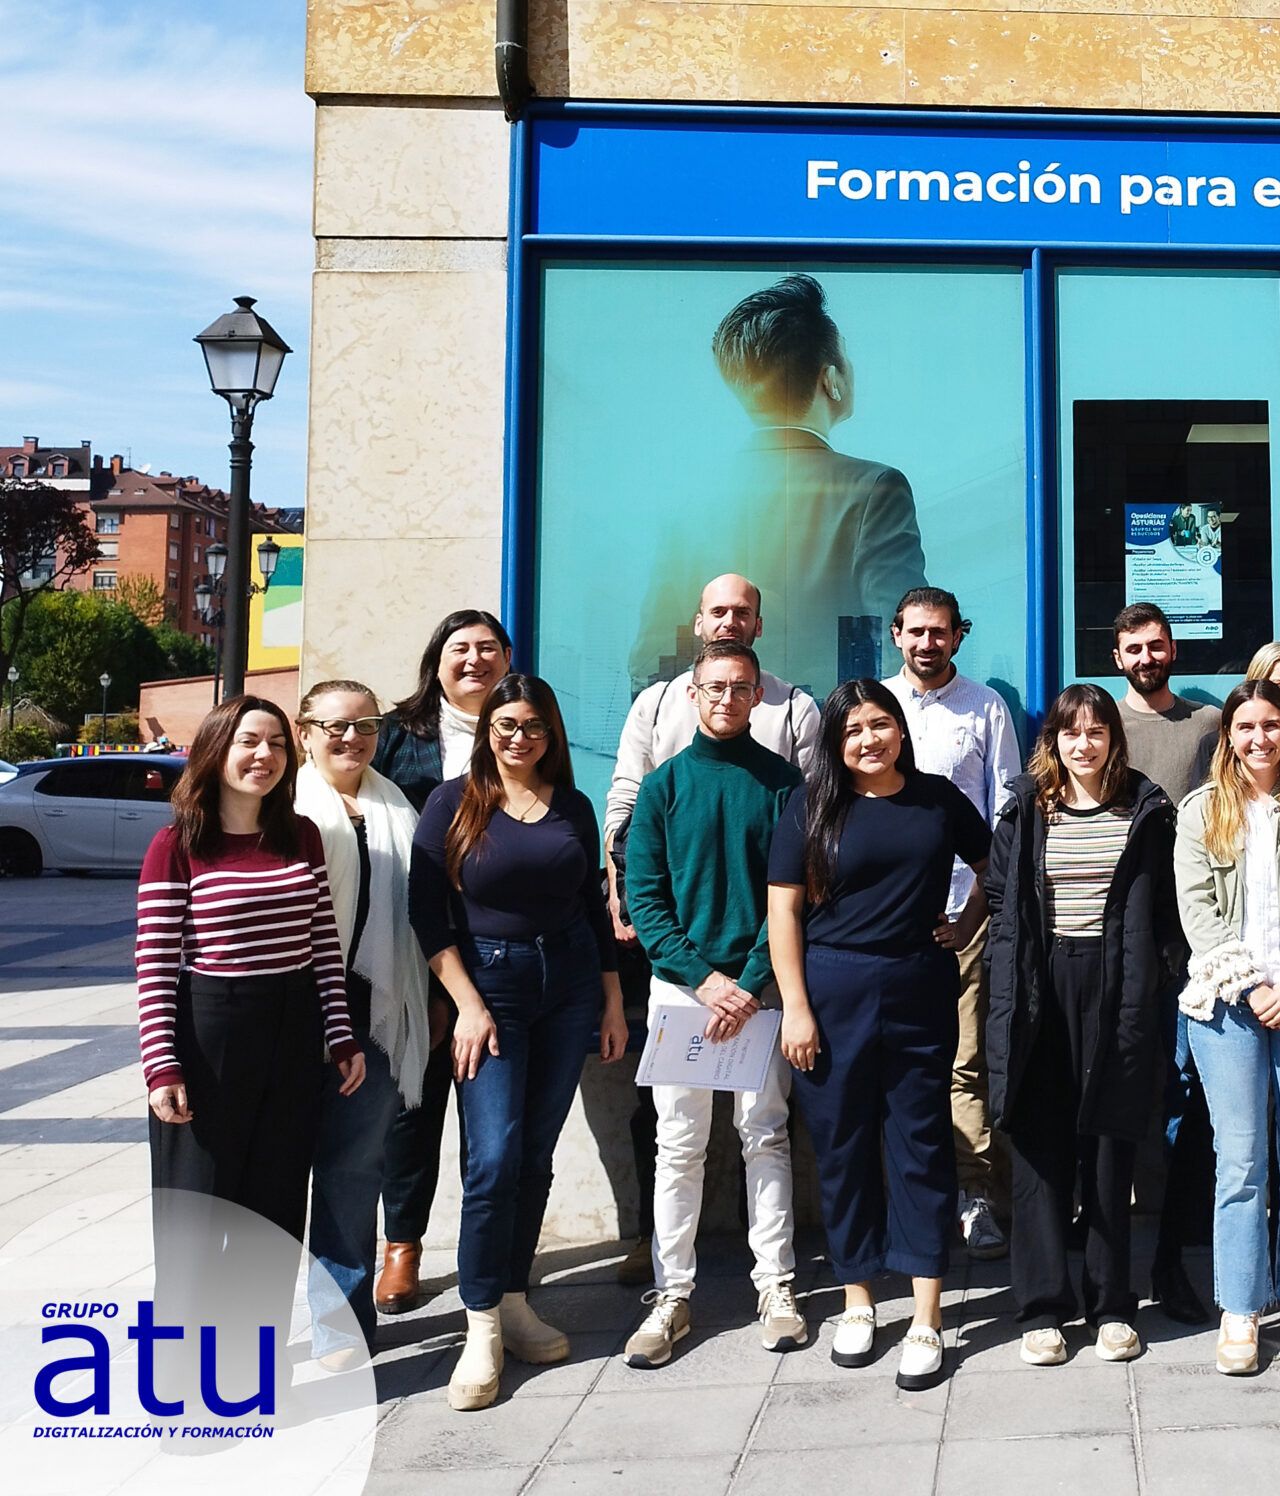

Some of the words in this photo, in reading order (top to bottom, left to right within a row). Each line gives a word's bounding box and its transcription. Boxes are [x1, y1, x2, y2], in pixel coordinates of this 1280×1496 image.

[807, 160, 1101, 203] Formación
[1120, 174, 1236, 214] para
[686, 1034, 704, 1062] atu
